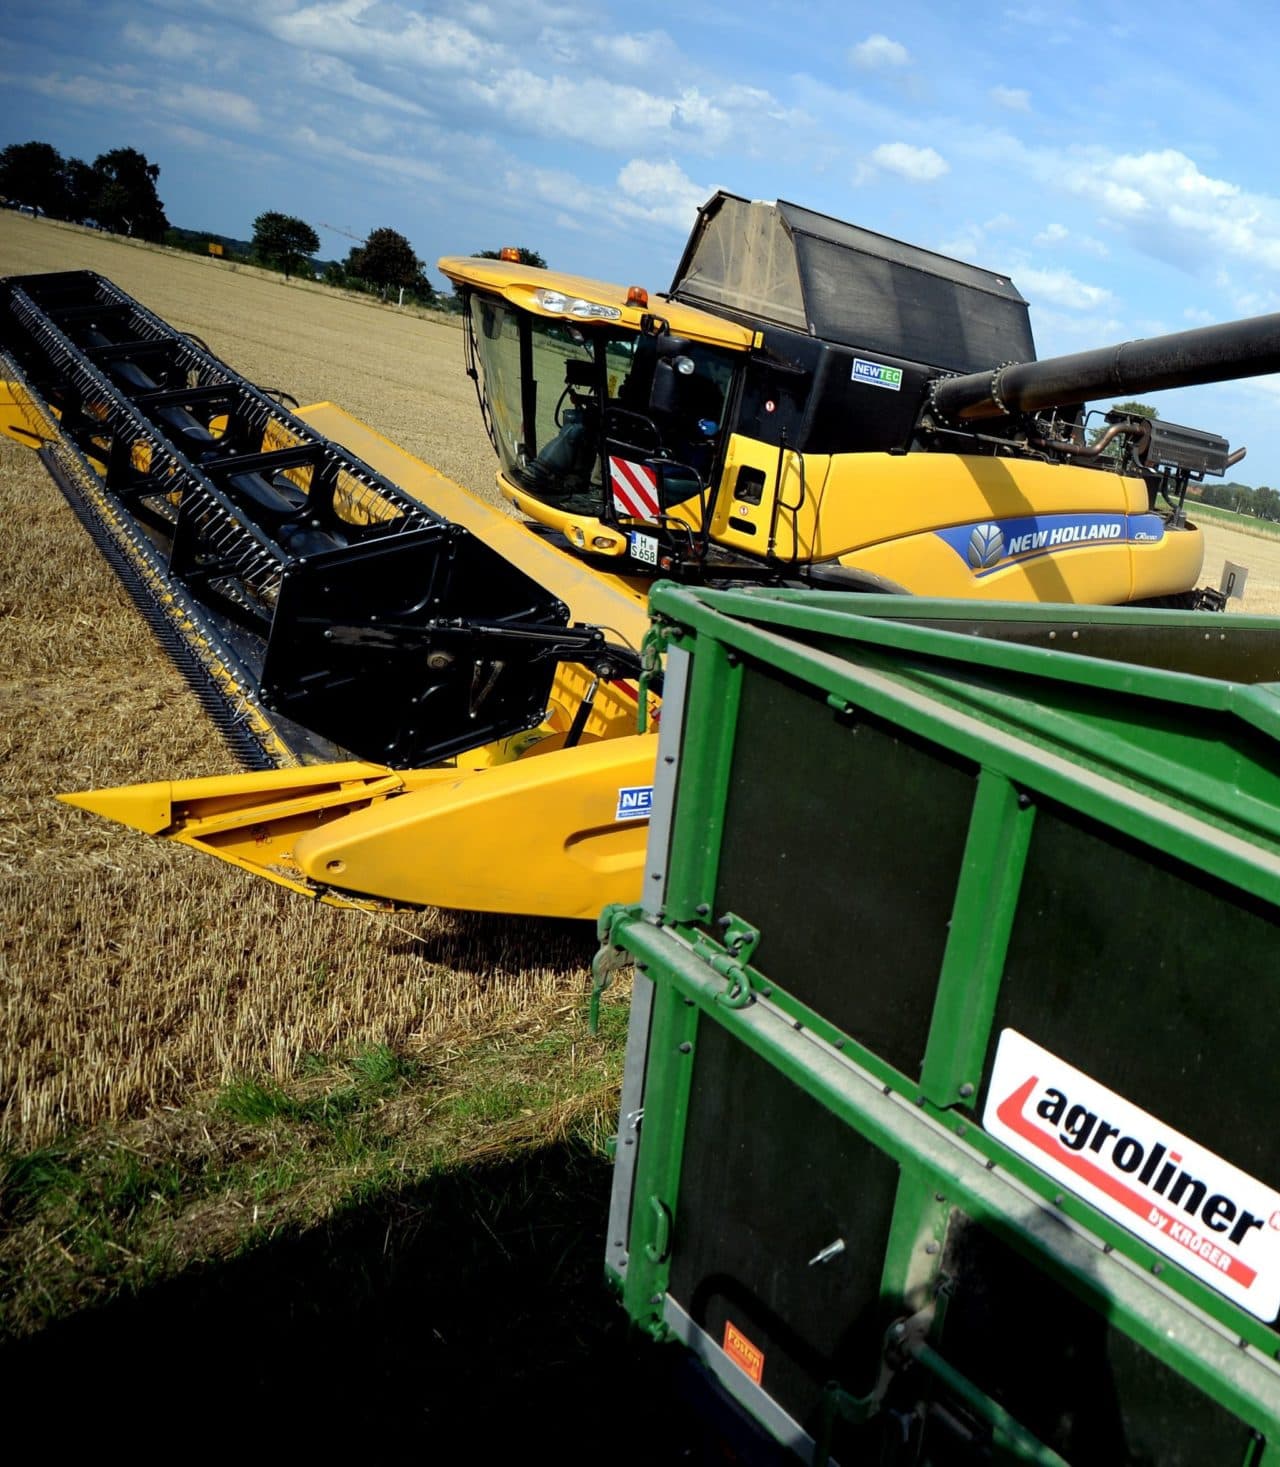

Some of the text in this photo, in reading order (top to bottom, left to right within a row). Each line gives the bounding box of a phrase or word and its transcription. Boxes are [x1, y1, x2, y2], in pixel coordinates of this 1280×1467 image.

[855, 362, 900, 382] NEWTEC
[640, 536, 647, 549] H
[1008, 524, 1121, 555] NEW HOLLAND
[631, 545, 656, 563] S 658
[622, 791, 653, 808] NE
[1036, 1087, 1265, 1246] agroliner
[1148, 1206, 1169, 1231] by
